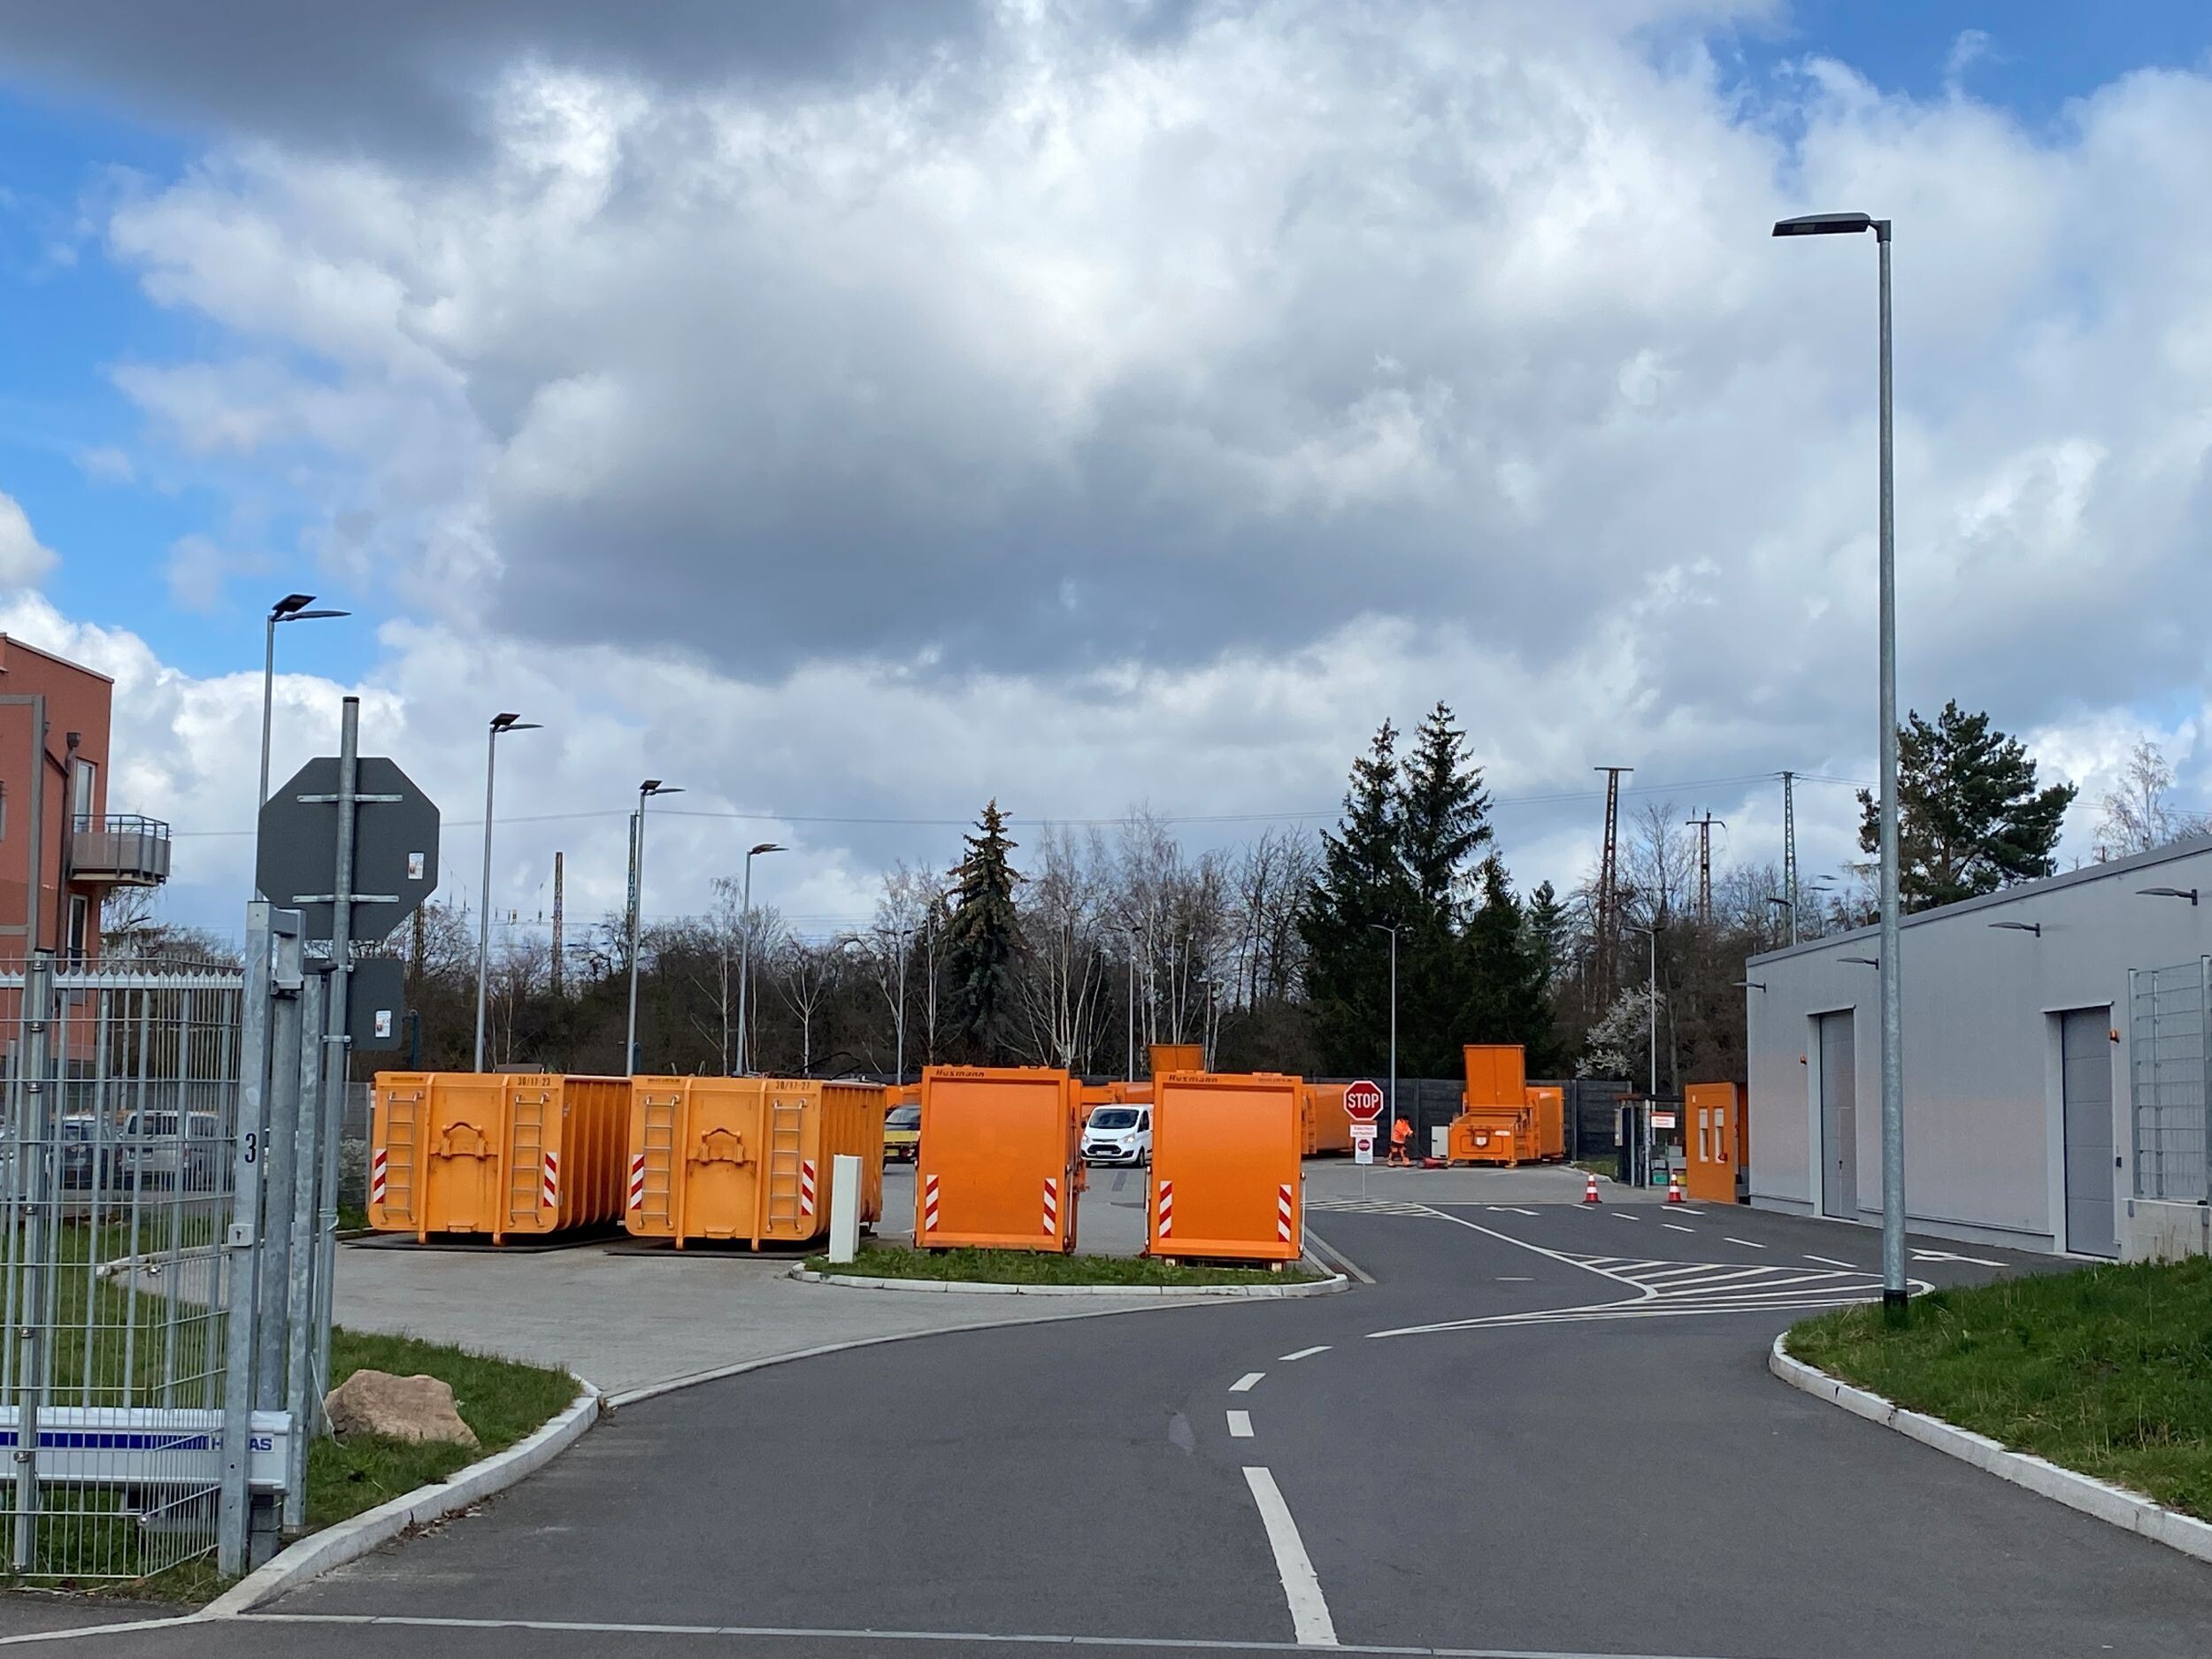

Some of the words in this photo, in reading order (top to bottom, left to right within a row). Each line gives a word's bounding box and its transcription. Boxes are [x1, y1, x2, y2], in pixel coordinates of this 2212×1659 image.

[935, 1068, 985, 1078] Husmann
[1168, 1074, 1218, 1083] Husmann
[1348, 1093, 1379, 1109] STOP
[244, 1133, 257, 1164] 3
[211, 1436, 273, 1451] HAS
